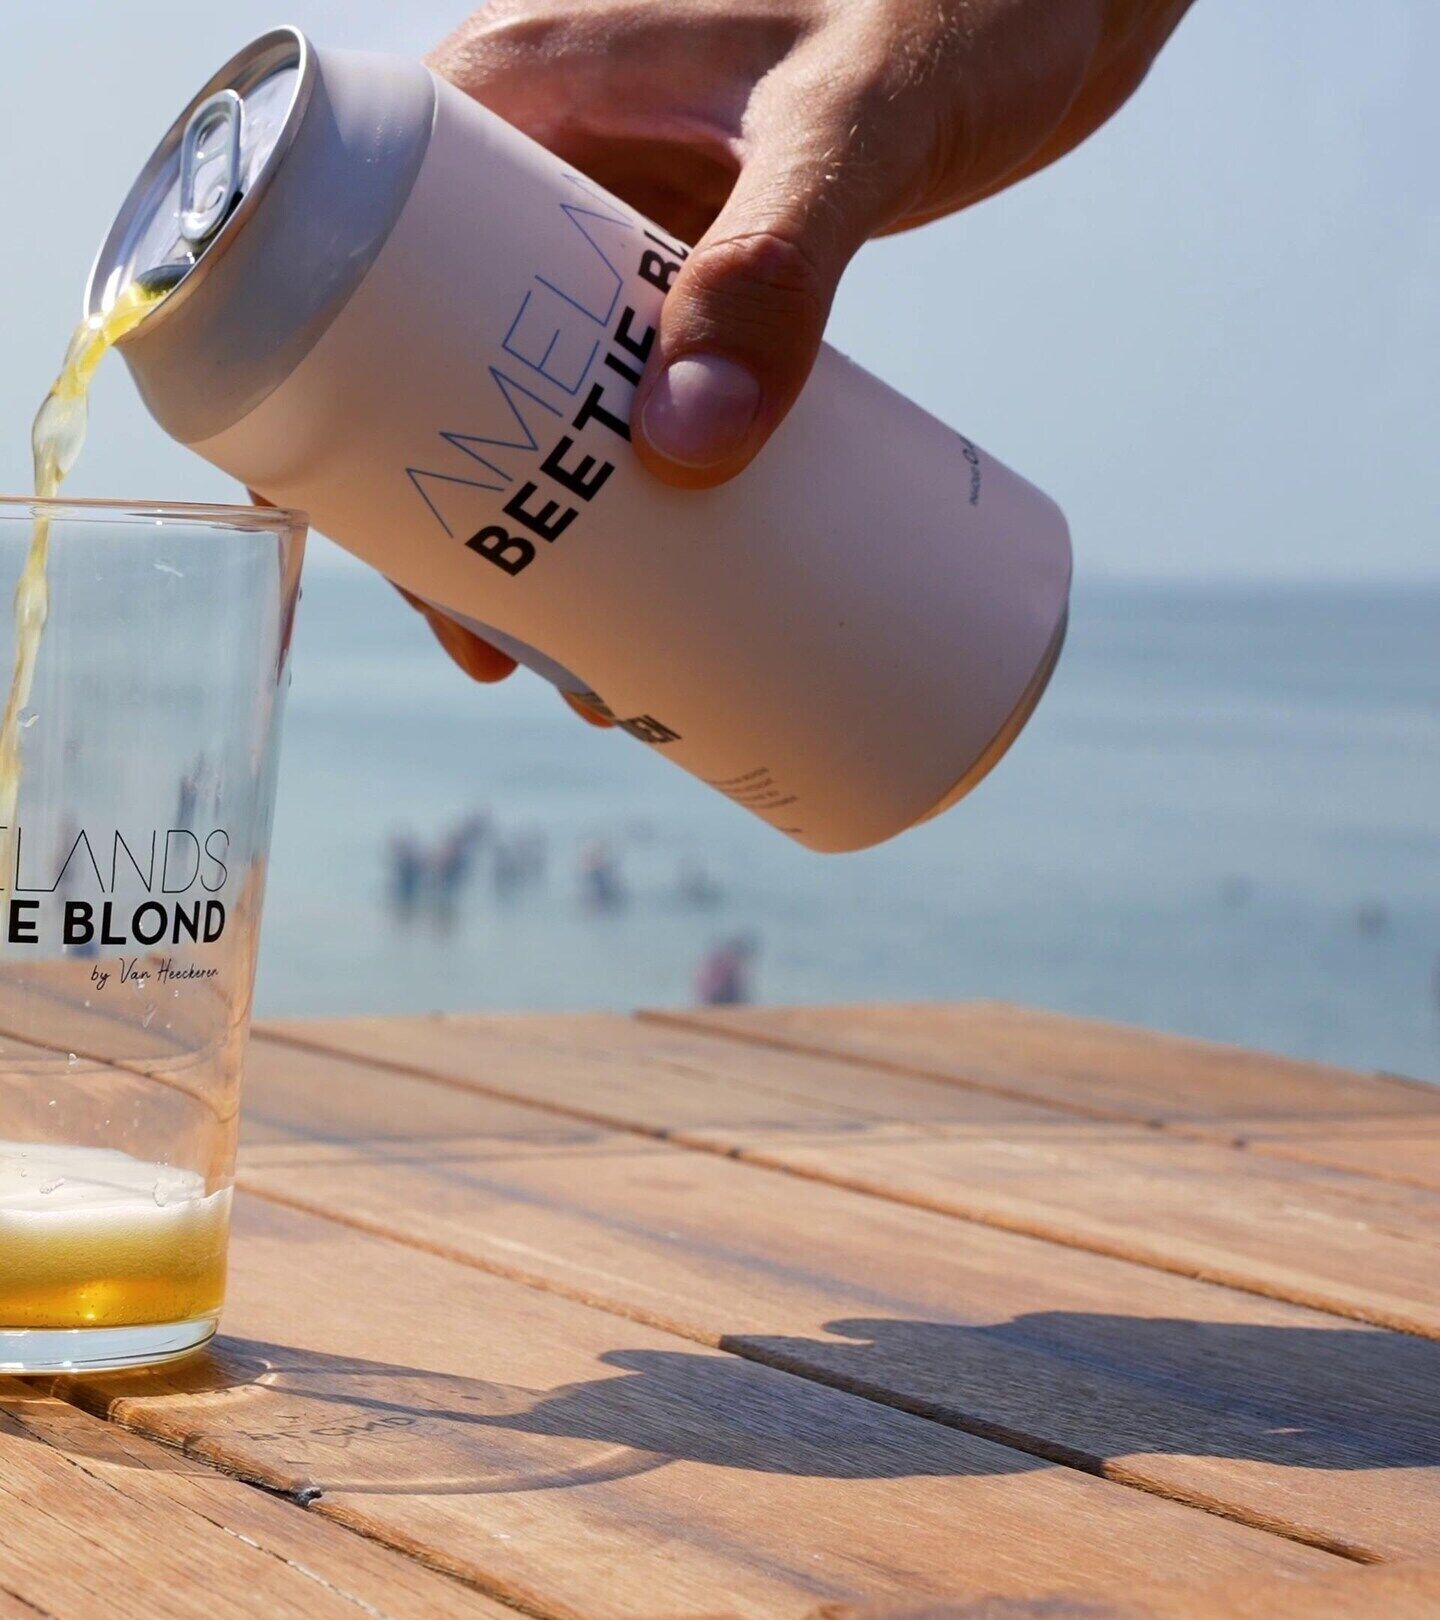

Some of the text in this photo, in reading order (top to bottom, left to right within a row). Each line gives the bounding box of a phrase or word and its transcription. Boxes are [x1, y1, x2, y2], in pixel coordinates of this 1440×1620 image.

[63, 899, 226, 946] BLOND
[91, 957, 220, 991] by Van Heeckeren
